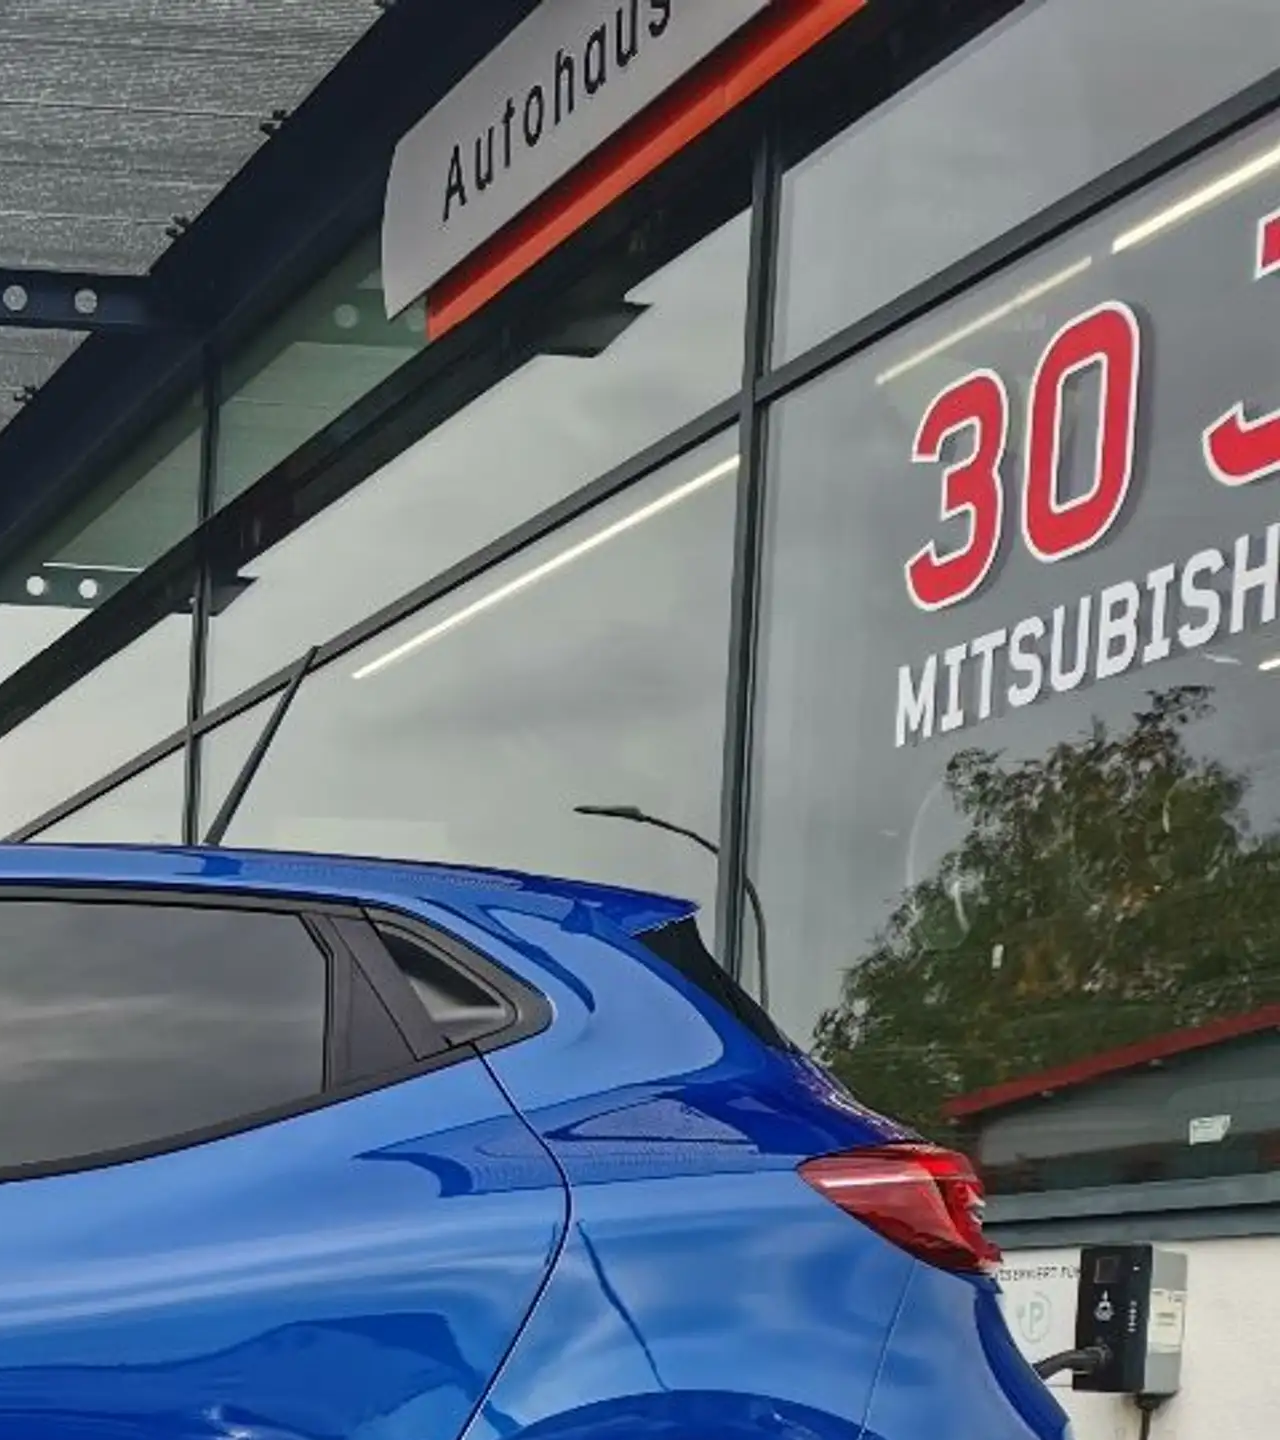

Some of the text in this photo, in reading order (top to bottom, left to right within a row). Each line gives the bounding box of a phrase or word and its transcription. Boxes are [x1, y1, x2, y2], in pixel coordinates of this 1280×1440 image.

[441, 0, 672, 222] Autohaus
[905, 300, 1140, 611] 30
[895, 522, 1280, 748] MITSUBISH
